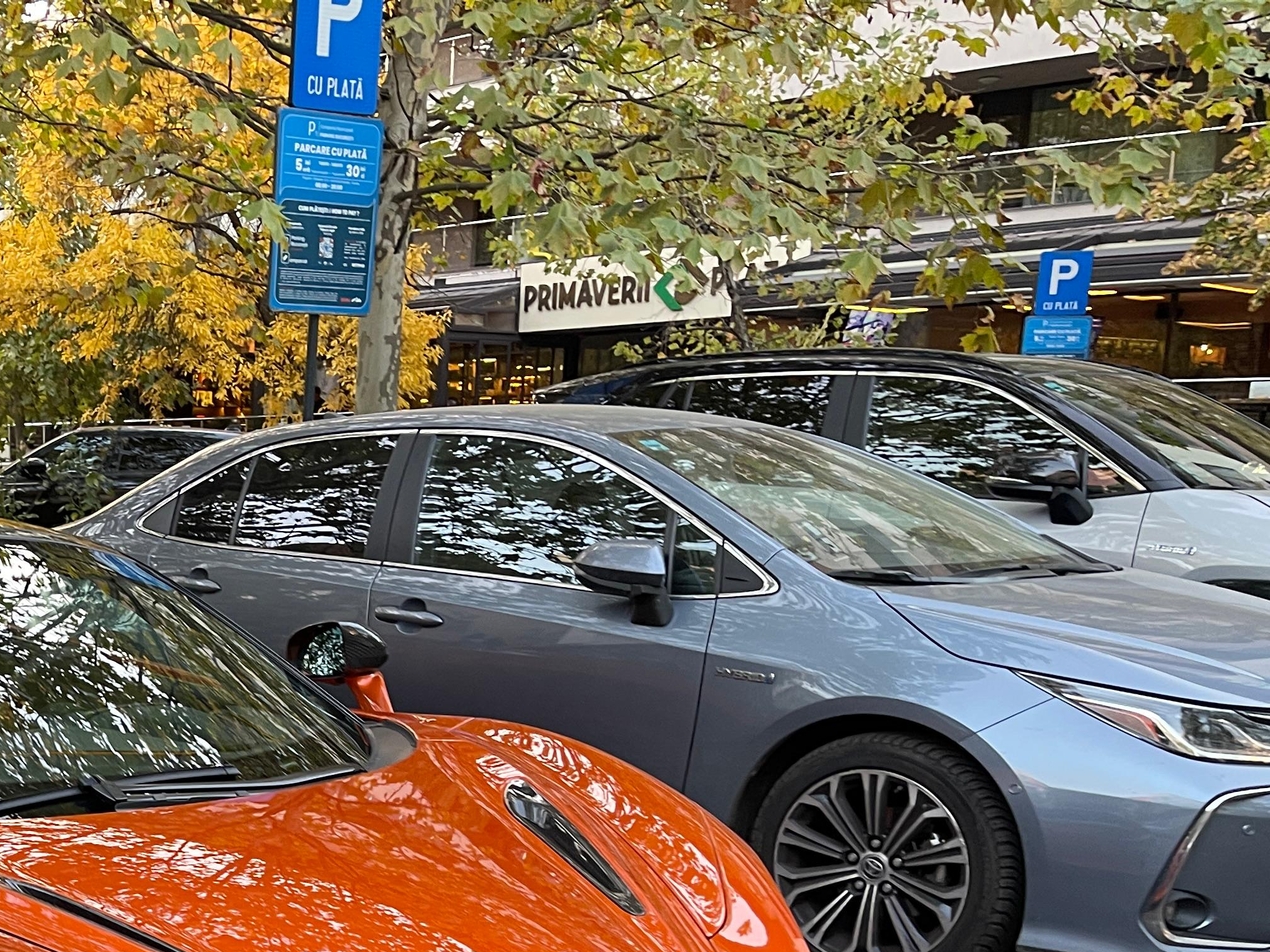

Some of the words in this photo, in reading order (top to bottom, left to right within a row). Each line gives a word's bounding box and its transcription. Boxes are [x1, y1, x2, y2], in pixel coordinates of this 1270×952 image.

[316, 0, 363, 58] P
[307, 75, 323, 96] CU
[326, 77, 364, 101] PLATĂ
[294, 142, 331, 157] PARCARE
[331, 147, 343, 157] CU
[343, 148, 368, 161] PLATĂ
[295, 158, 303, 172] 5
[345, 163, 360, 178] 30
[1048, 259, 1080, 296] P
[1042, 301, 1053, 310] CU
[1054, 301, 1079, 311] PLATĂ
